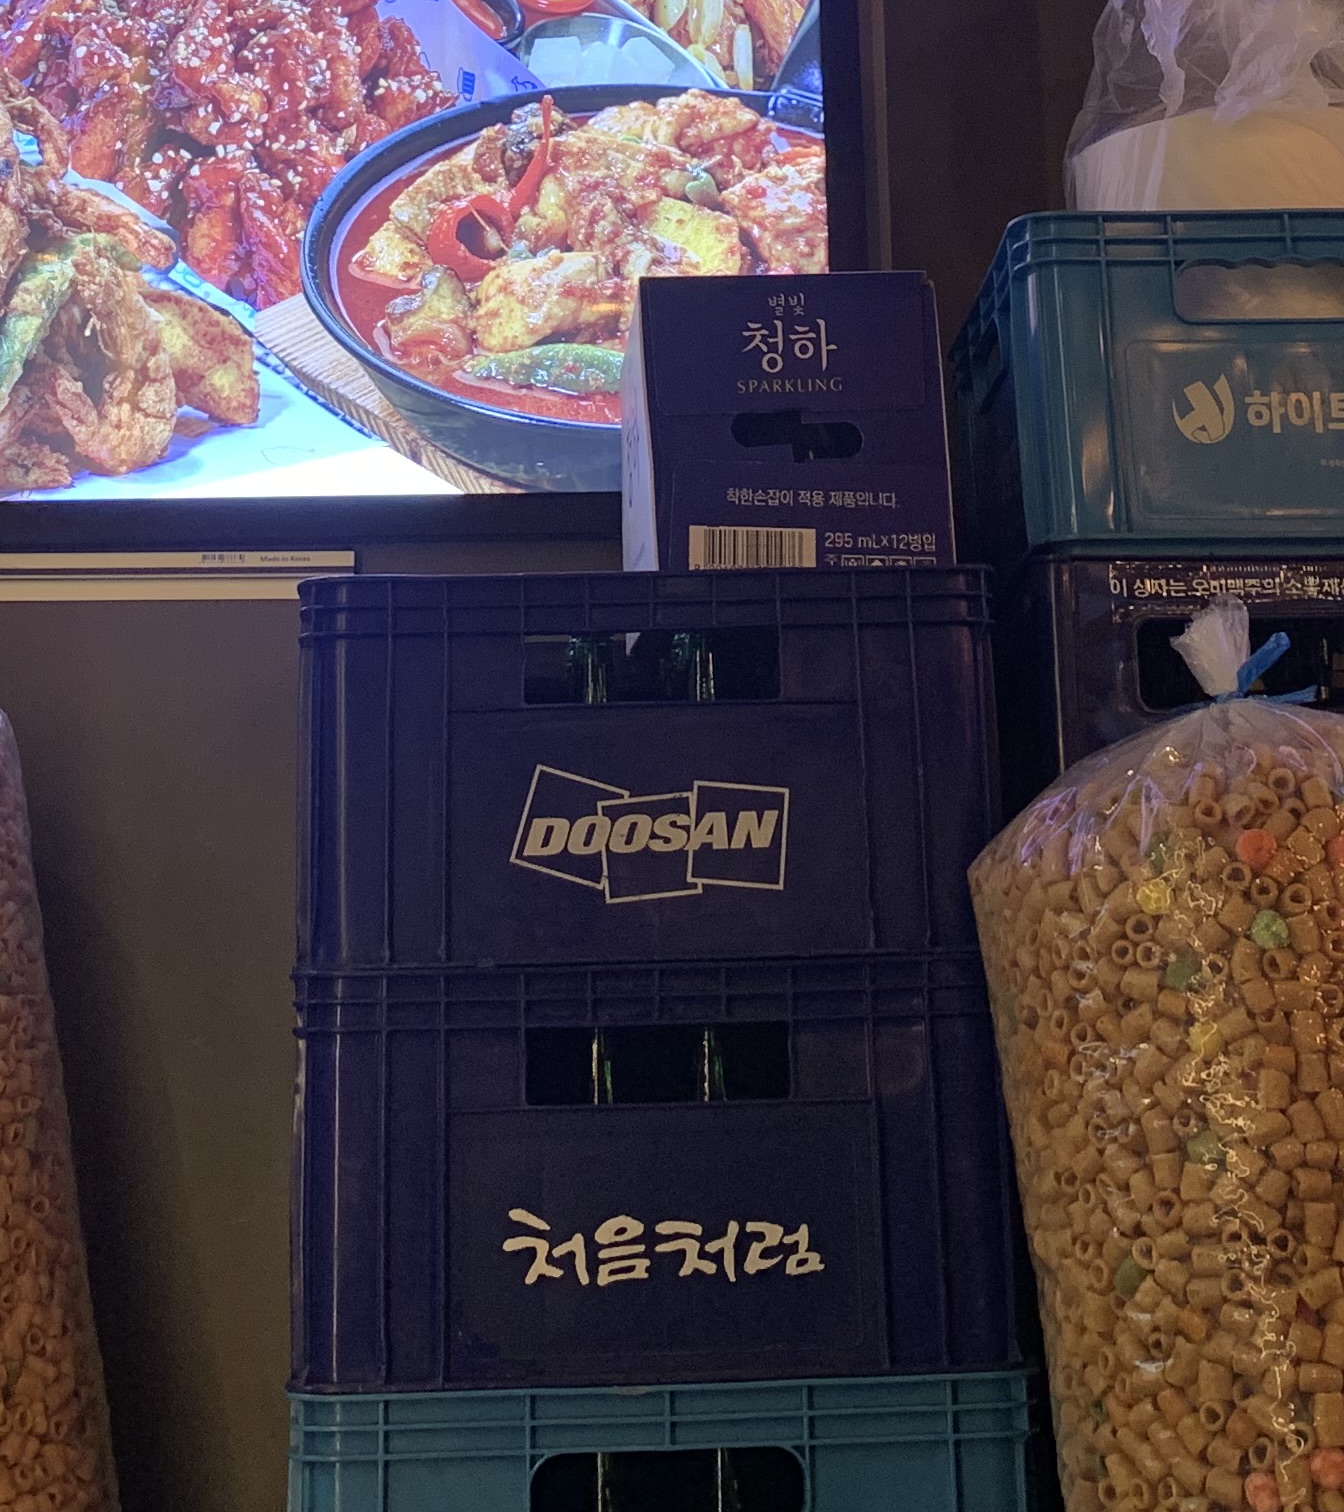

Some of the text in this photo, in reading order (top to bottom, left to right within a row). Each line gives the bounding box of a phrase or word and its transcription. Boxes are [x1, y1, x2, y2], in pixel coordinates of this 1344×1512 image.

[767, 292, 806, 317] 별빛
[741, 318, 839, 374] 청하
[736, 376, 844, 394] SPARKLING
[725, 487, 794, 507] 착한손잡이
[798, 489, 825, 507] 적용
[824, 531, 854, 549] 295
[1110, 579, 1129, 598] 이
[522, 809, 780, 857] DOOSAN
[501, 1207, 825, 1287] 처음처럼
